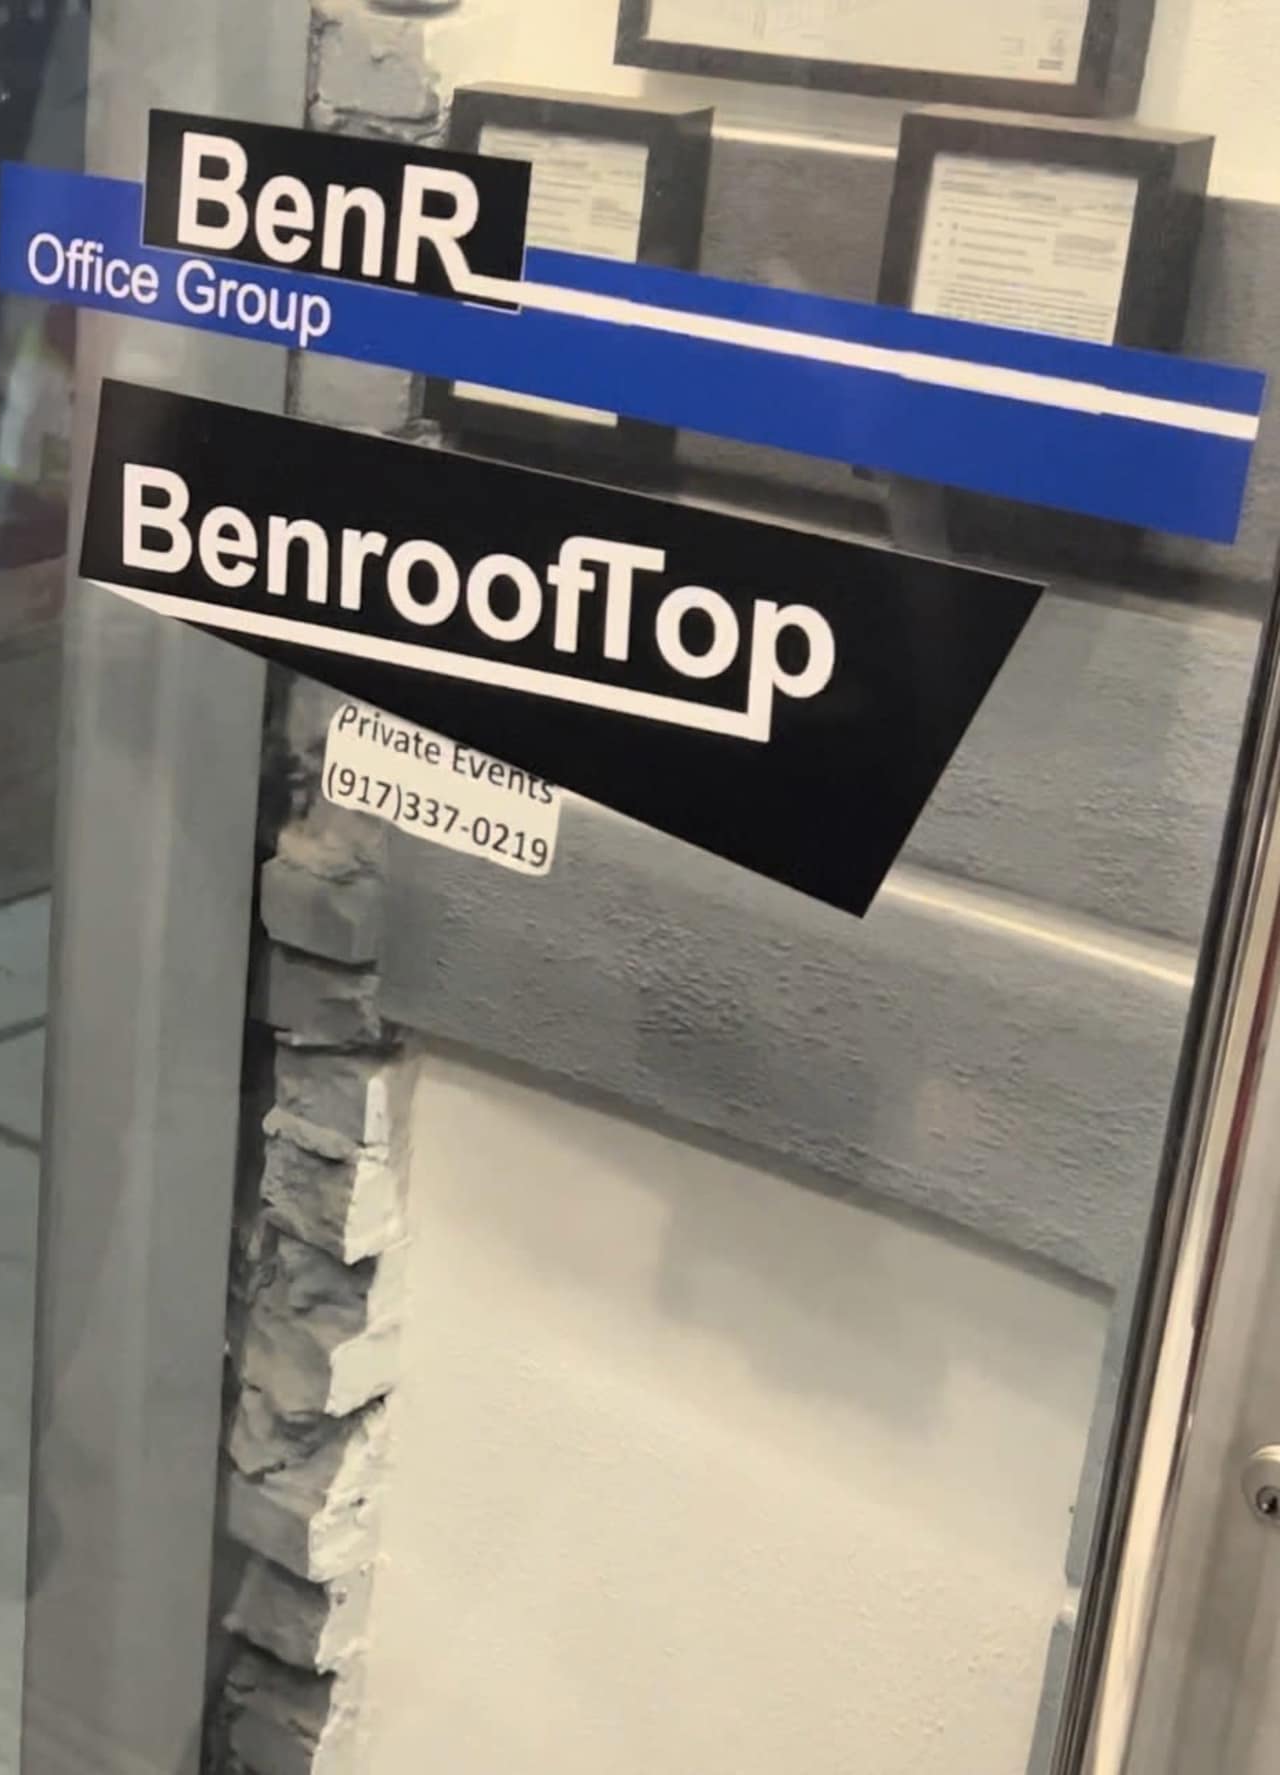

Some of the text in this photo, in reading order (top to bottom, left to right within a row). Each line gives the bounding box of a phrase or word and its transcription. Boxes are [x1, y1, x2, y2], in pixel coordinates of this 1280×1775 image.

[177, 132, 482, 295] BenR
[27, 232, 332, 348] Office Group
[124, 463, 836, 742] BenroofTop
[338, 703, 555, 804] Private Events
[326, 761, 549, 868] (917)337-0219
